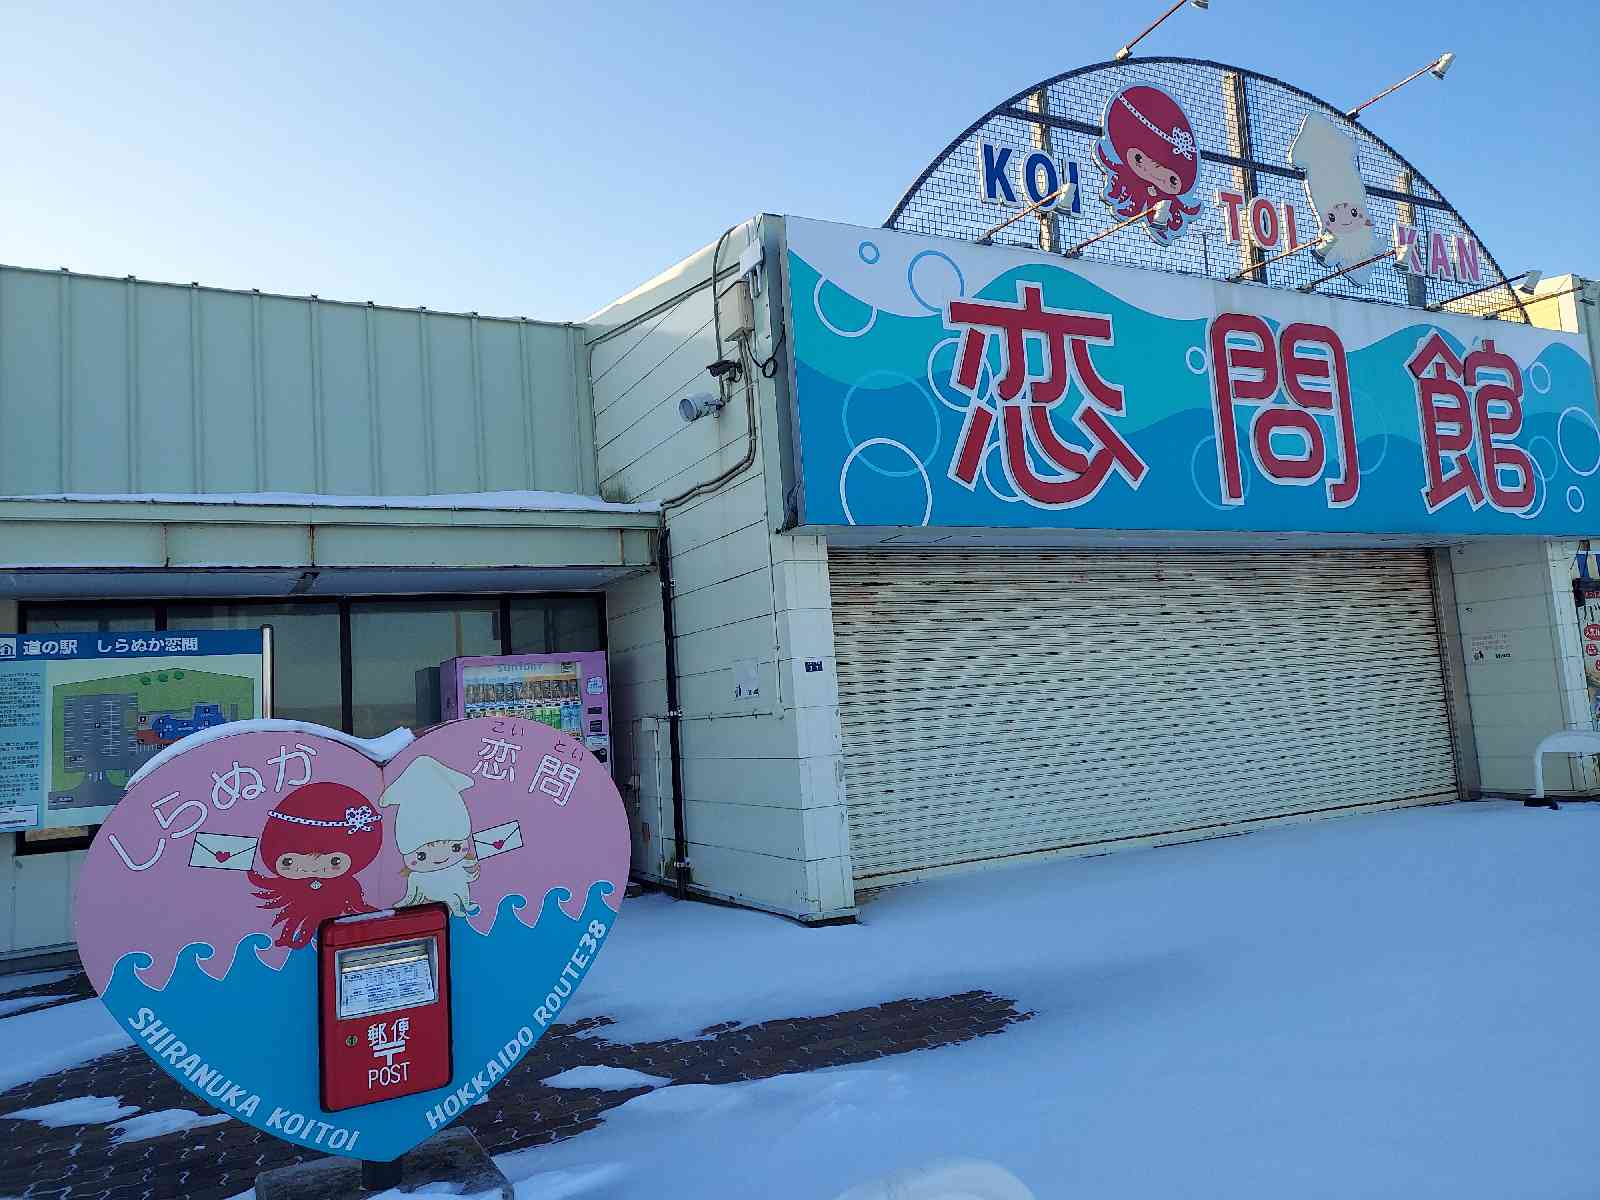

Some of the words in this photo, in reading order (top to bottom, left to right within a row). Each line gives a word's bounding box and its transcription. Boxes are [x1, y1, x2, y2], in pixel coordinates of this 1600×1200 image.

[981, 140, 1083, 217] KOI
[1217, 190, 1298, 250] TOI
[1394, 223, 1481, 283] KAN
[943, 281, 1538, 513] 恋問館
[23, 639, 78, 656] 道の駅
[97, 637, 199, 653] しらぬか恋問
[471, 736, 582, 807] 恋問
[490, 720, 525, 737] こい
[554, 738, 584, 761] とい
[108, 743, 319, 872] しらぬか
[367, 1016, 411, 1047] 郵便
[425, 1025, 535, 1130] HOKKAIDO
[532, 918, 608, 1027] ROUTE38
[127, 1006, 262, 1118] SHIRANUKA
[265, 1106, 361, 1152] KOITOI
[368, 1060, 411, 1089] POST
